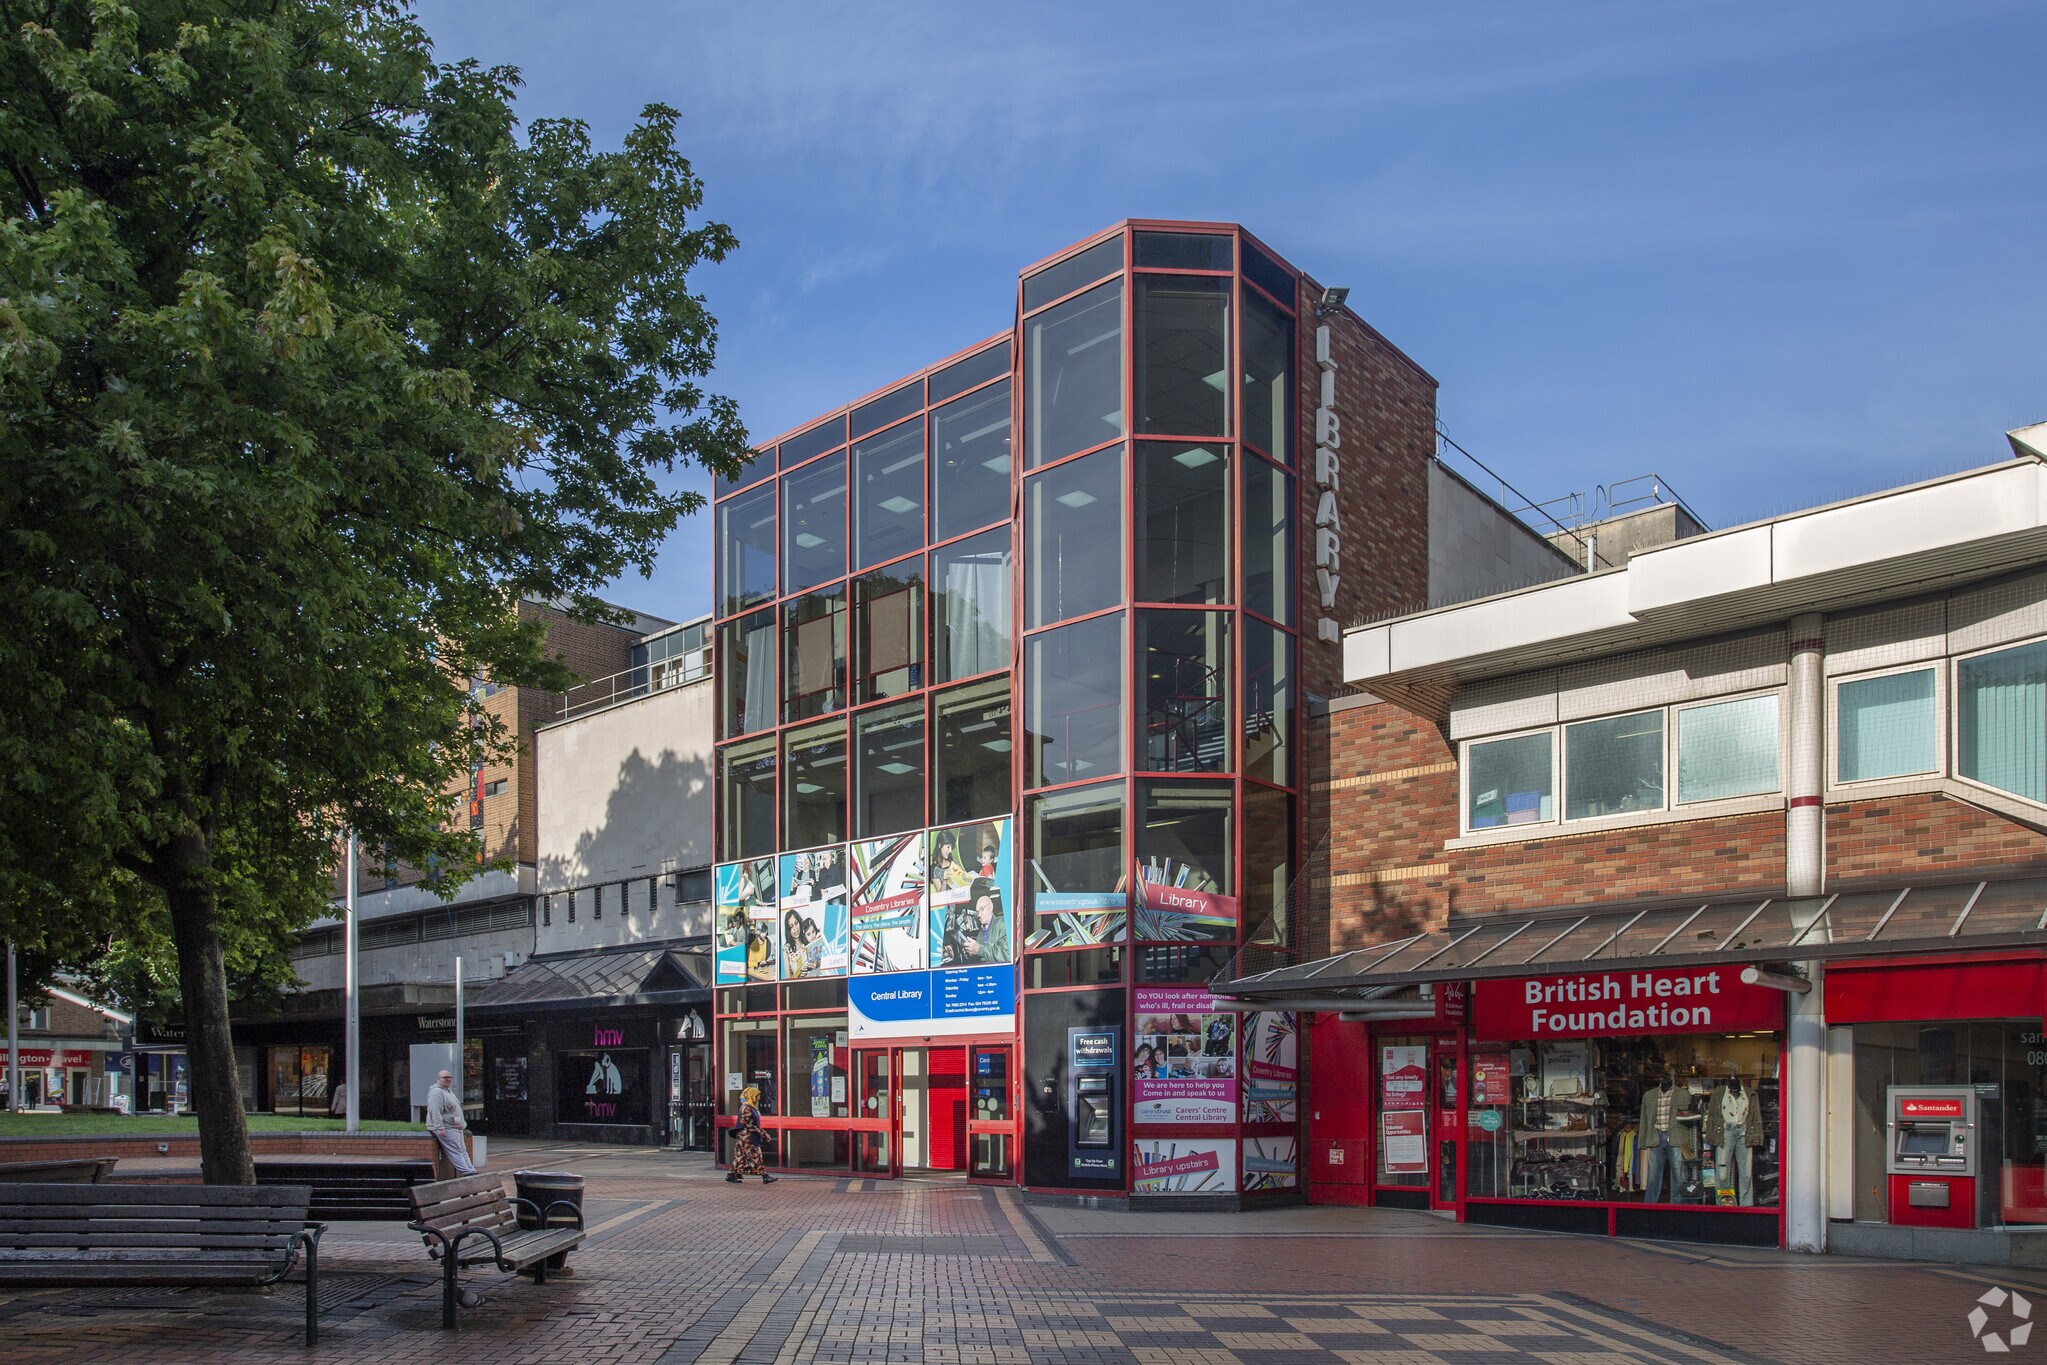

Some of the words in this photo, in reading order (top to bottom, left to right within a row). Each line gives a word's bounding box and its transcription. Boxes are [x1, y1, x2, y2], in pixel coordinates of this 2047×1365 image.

[1316, 325, 1340, 611] LIBRARY
[865, 903, 890, 914] Coventry
[890, 898, 915, 909] Libraries
[1160, 892, 1208, 913] Library
[1525, 974, 1621, 1005] British
[1631, 970, 1721, 999] Heart
[871, 991, 897, 1001] Central
[897, 990, 923, 1000] Library
[1165, 992, 1181, 1000] look
[1181, 992, 1198, 1000] after
[1161, 1002, 1171, 1010] ill,
[1532, 1001, 1712, 1033] Foundation
[151, 1027, 187, 1038] Water
[594, 1024, 624, 1046] hmv
[1094, 1037, 1108, 1045] cash
[1076, 1046, 1113, 1055] withdrawals
[1549, 1056, 1571, 1065] prices
[1252, 1066, 1273, 1078] Coventry
[1273, 1069, 1293, 1079] Libraries
[1195, 1082, 1211, 1090] help
[588, 1098, 617, 1117] hmv
[1202, 1106, 1227, 1114] Centre
[1202, 1114, 1228, 1122] Library
[1143, 1165, 1174, 1176] Library
[1175, 1159, 1209, 1172] upstairs
